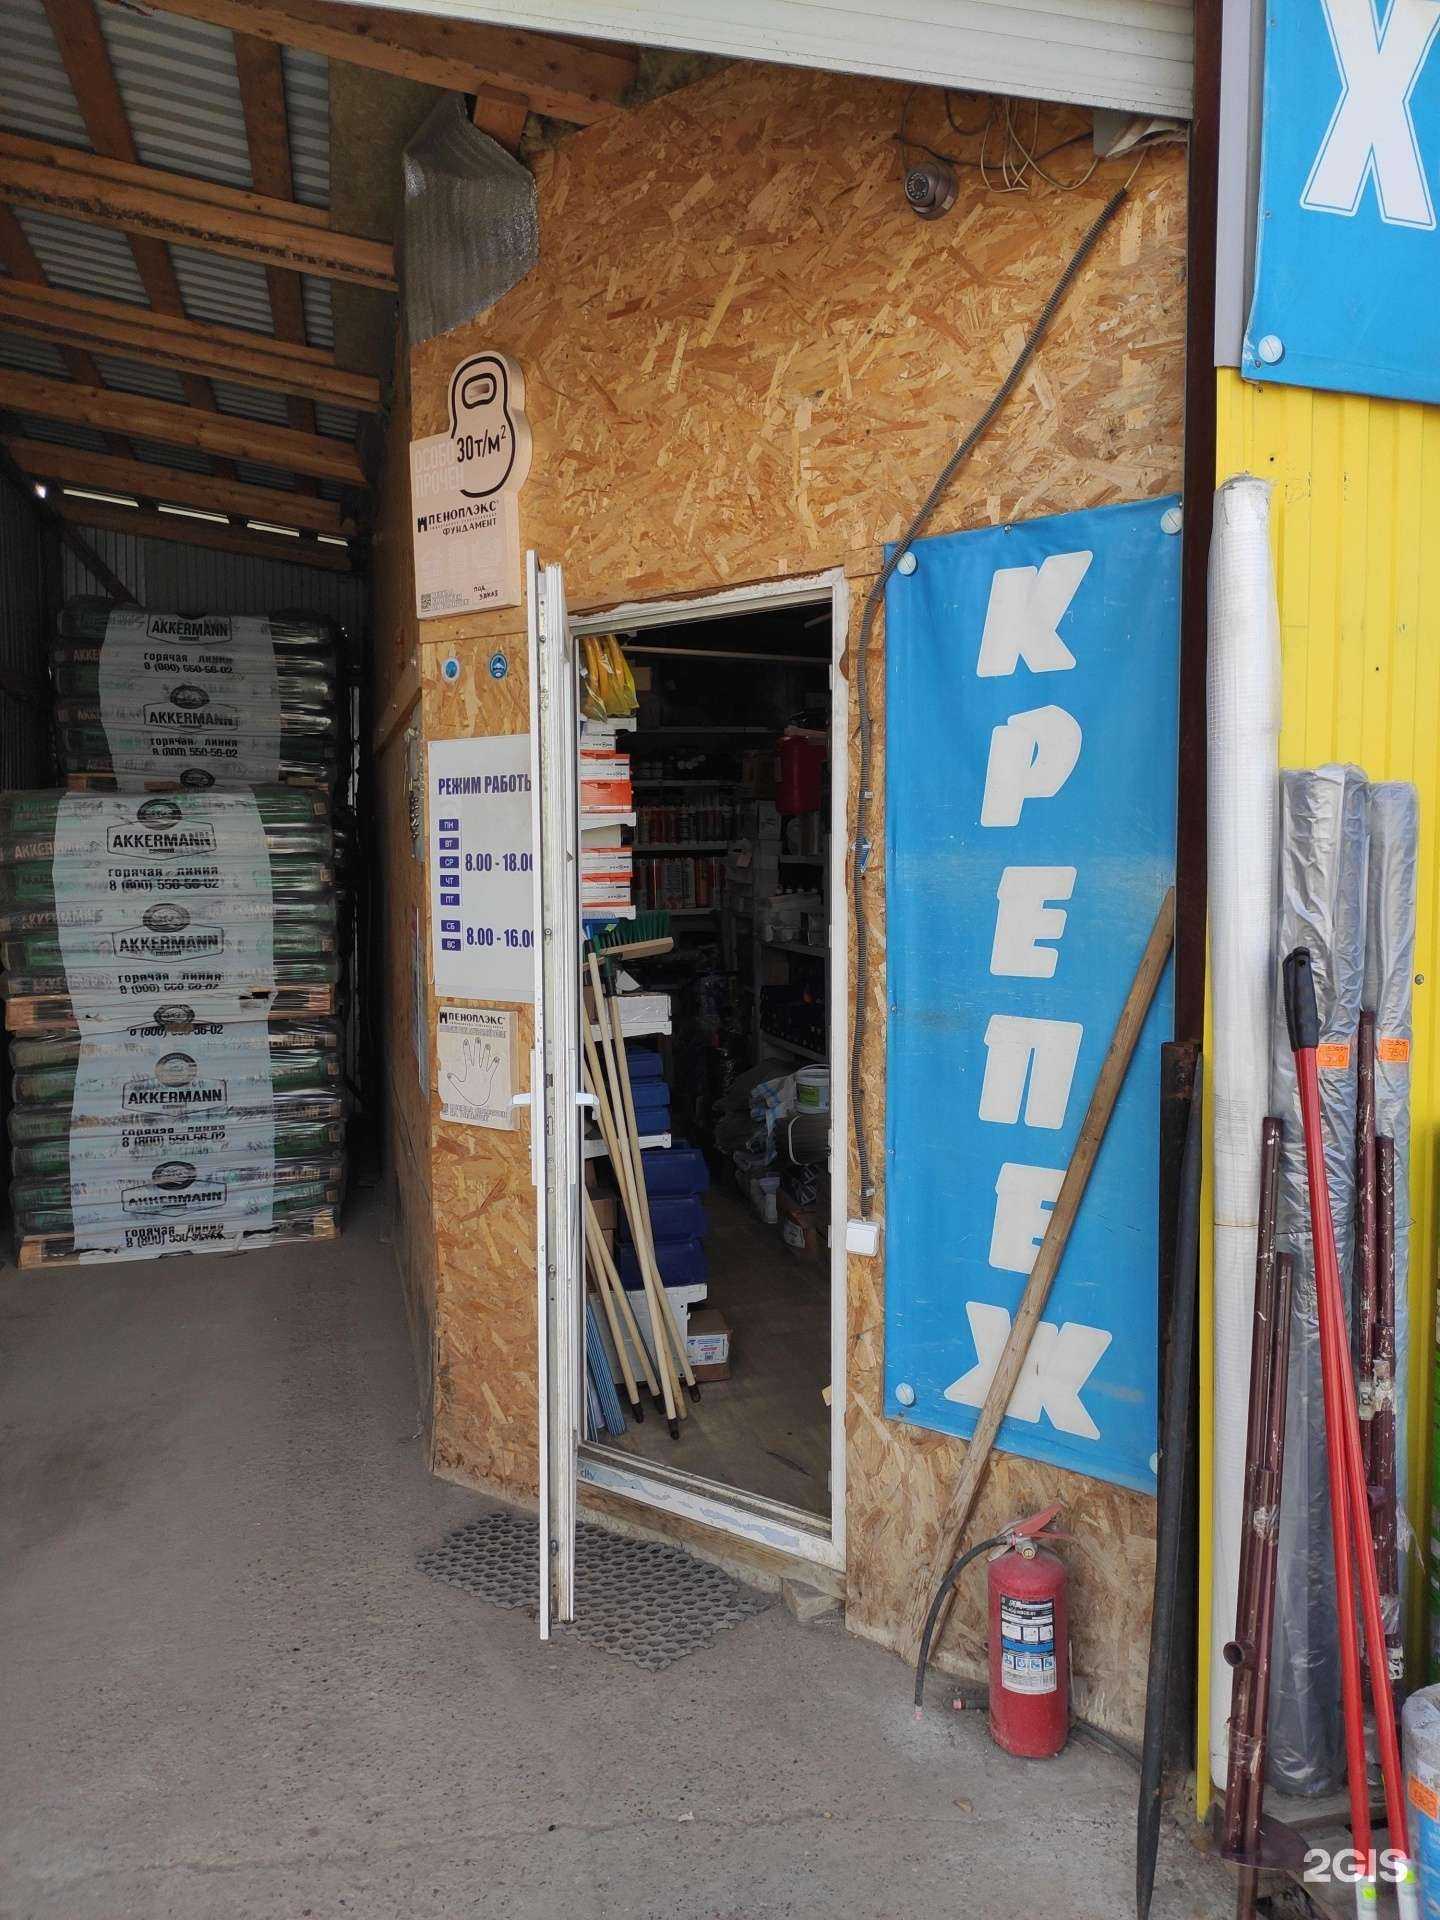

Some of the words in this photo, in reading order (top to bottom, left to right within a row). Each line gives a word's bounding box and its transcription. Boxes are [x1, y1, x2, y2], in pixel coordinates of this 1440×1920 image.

[428, 500, 497, 525] ПЕНОПЛЭКС
[442, 517, 497, 535] ФУНДАМЕНТ
[151, 620, 228, 636] AKKERMANN
[438, 776, 481, 796] РЕЖИМ
[443, 821, 454, 830] ПН
[112, 833, 211, 849] AKKERMANN
[444, 839, 453, 848] ВТ
[444, 858, 454, 866] СР
[465, 853, 492, 872] 8.00
[445, 877, 454, 885] ЧТ
[445, 896, 454, 904] ПТ
[446, 922, 455, 930] СБ
[119, 935, 219, 952] AKKERMANN
[466, 927, 494, 946] 8.00
[446, 941, 456, 949] ВС
[944, 550, 1111, 1440] КРЕПЕЖ
[448, 1012, 503, 1025] ПЕНОПЛЭКС
[127, 1089, 223, 1104] AKKERMANN
